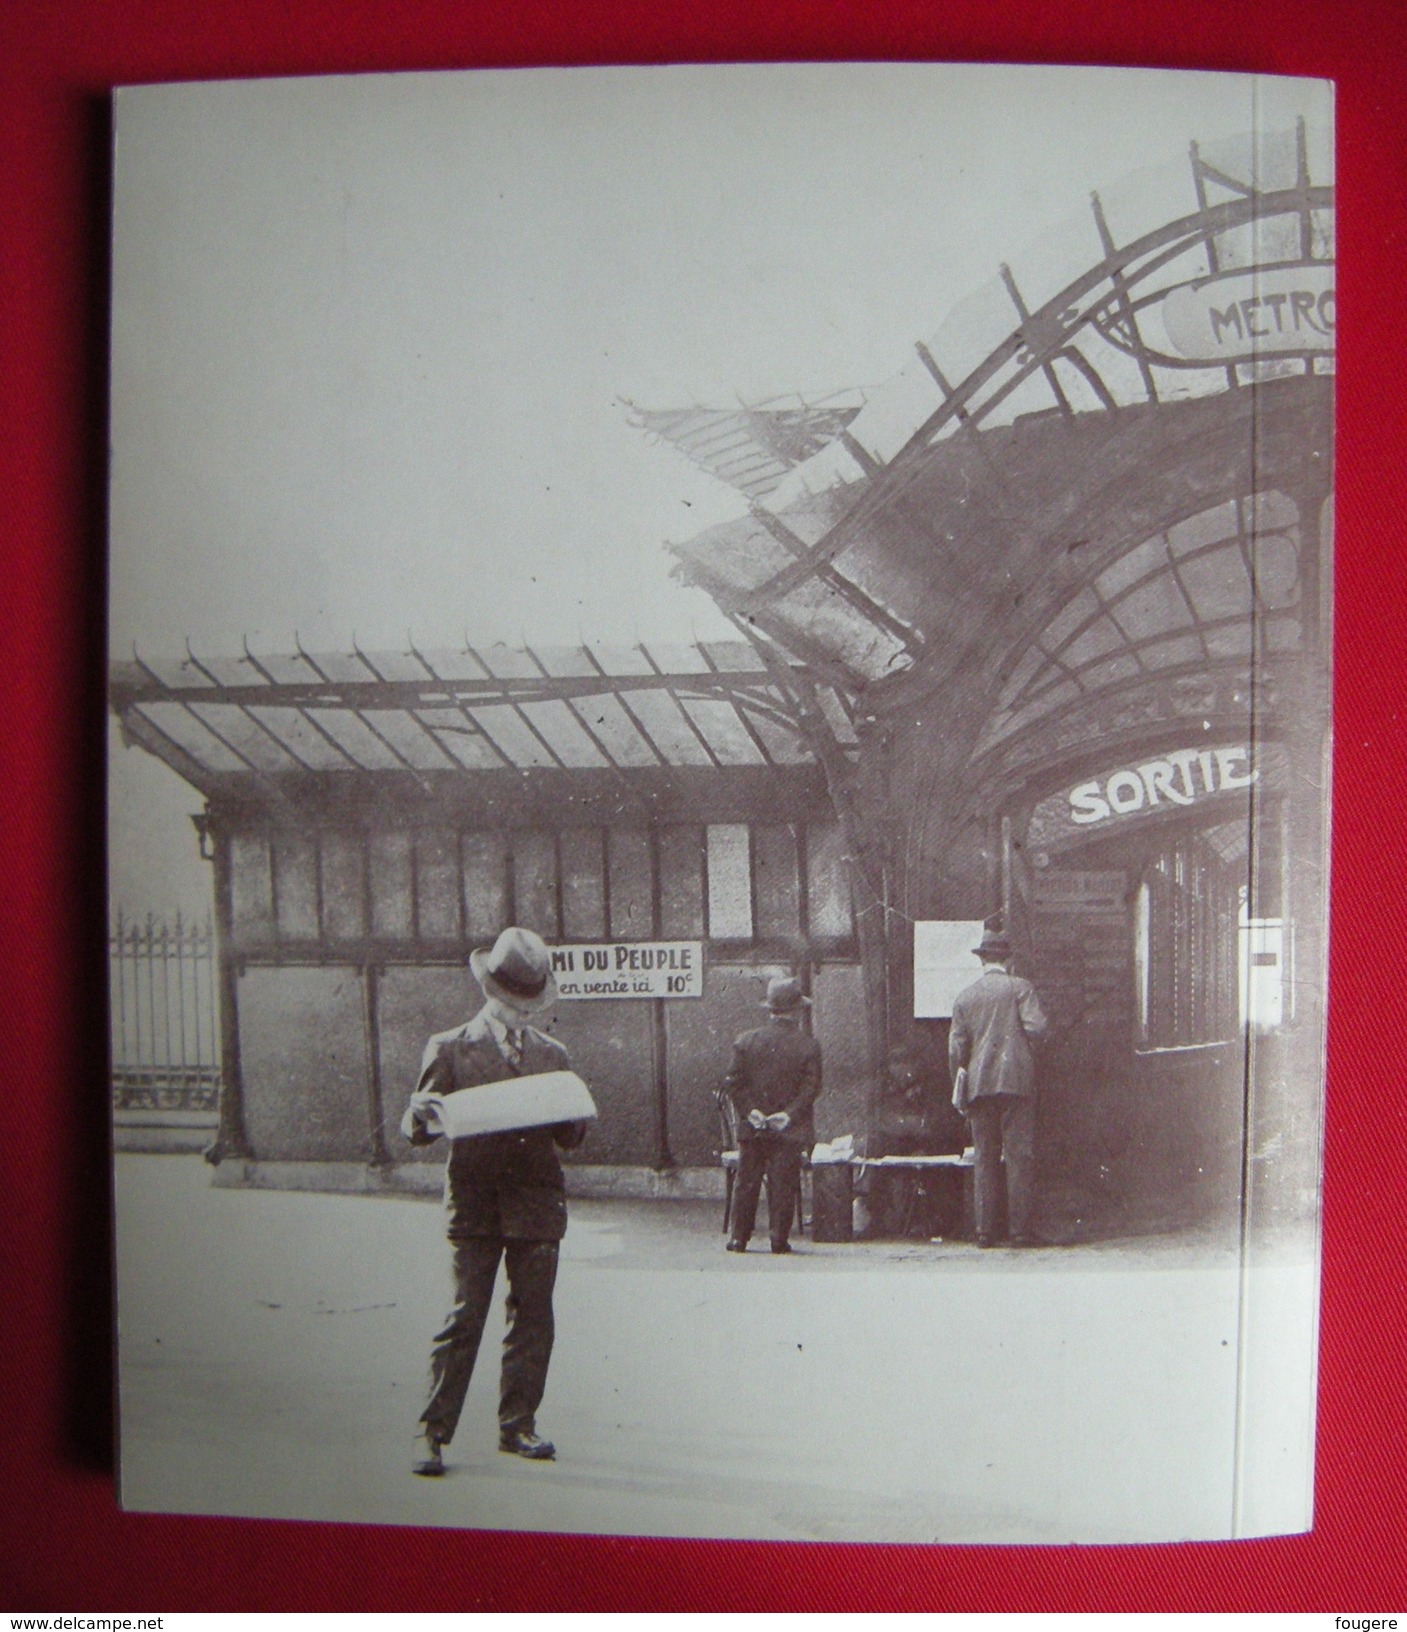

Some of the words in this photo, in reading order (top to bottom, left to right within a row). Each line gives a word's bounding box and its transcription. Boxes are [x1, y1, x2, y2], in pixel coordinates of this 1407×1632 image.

[1069, 748, 1260, 824] SORTIE
[584, 950, 608, 971] DU
[615, 946, 691, 970] PEUPLE
[560, 982, 581, 994] en
[584, 978, 628, 994] vente
[633, 977, 653, 993] ici
